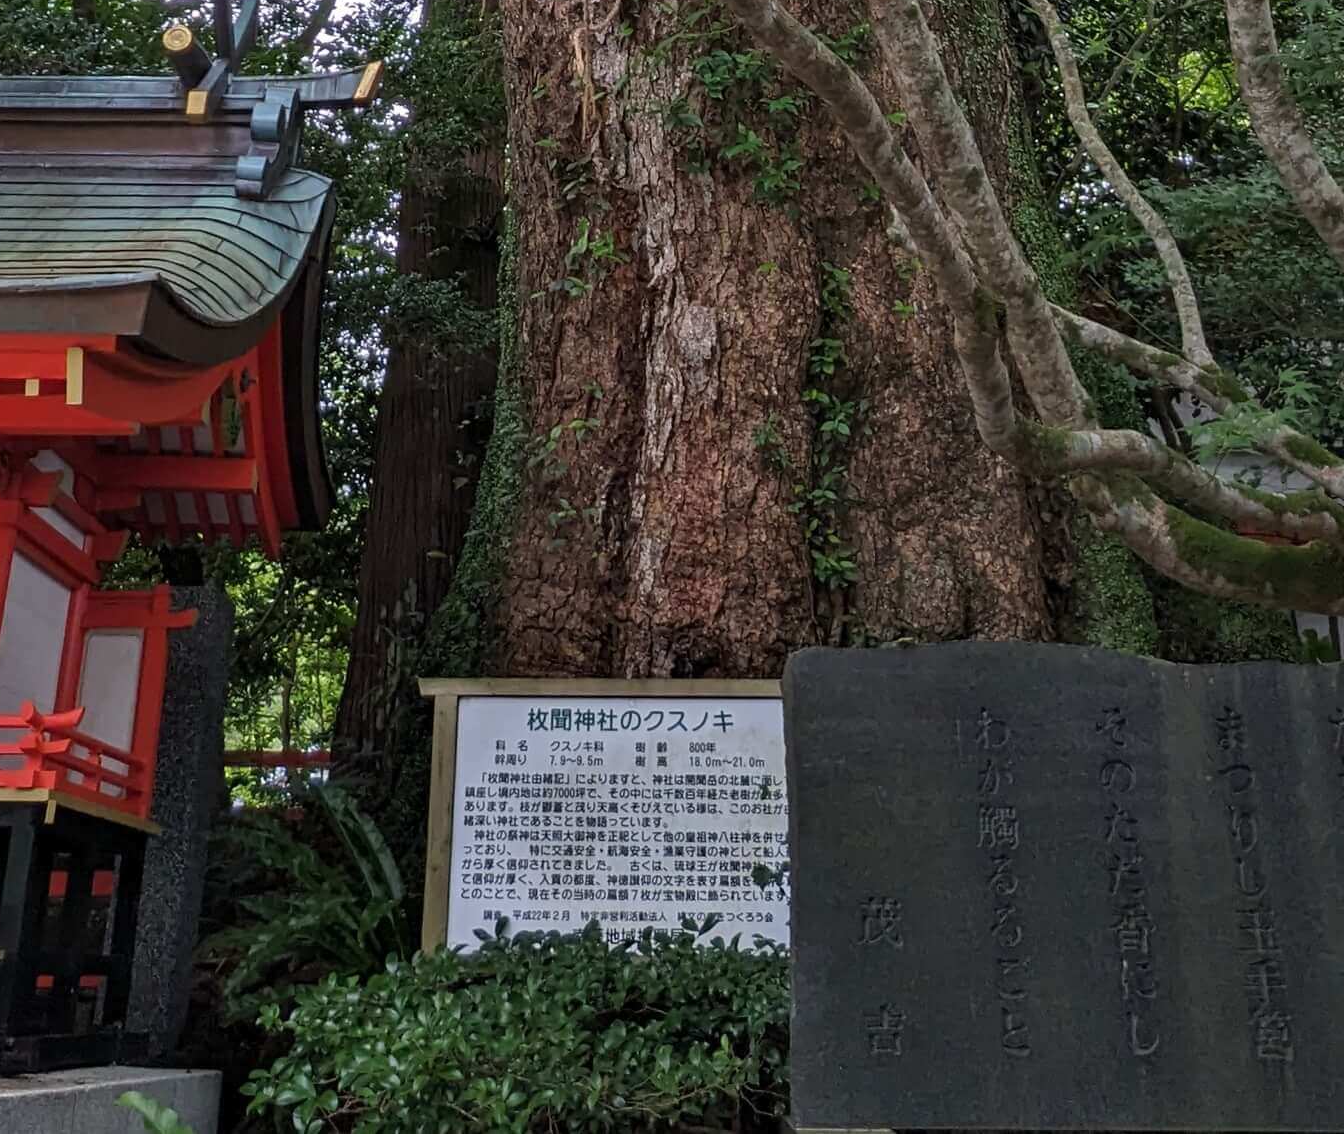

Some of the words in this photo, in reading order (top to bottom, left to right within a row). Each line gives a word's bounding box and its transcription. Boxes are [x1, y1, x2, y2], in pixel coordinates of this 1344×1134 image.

[527, 708, 734, 733] 枚聞神社のクスノキ
[550, 741, 604, 753] クスノキ科
[689, 742, 717, 754] 800年
[495, 754, 528, 766] 幹周り
